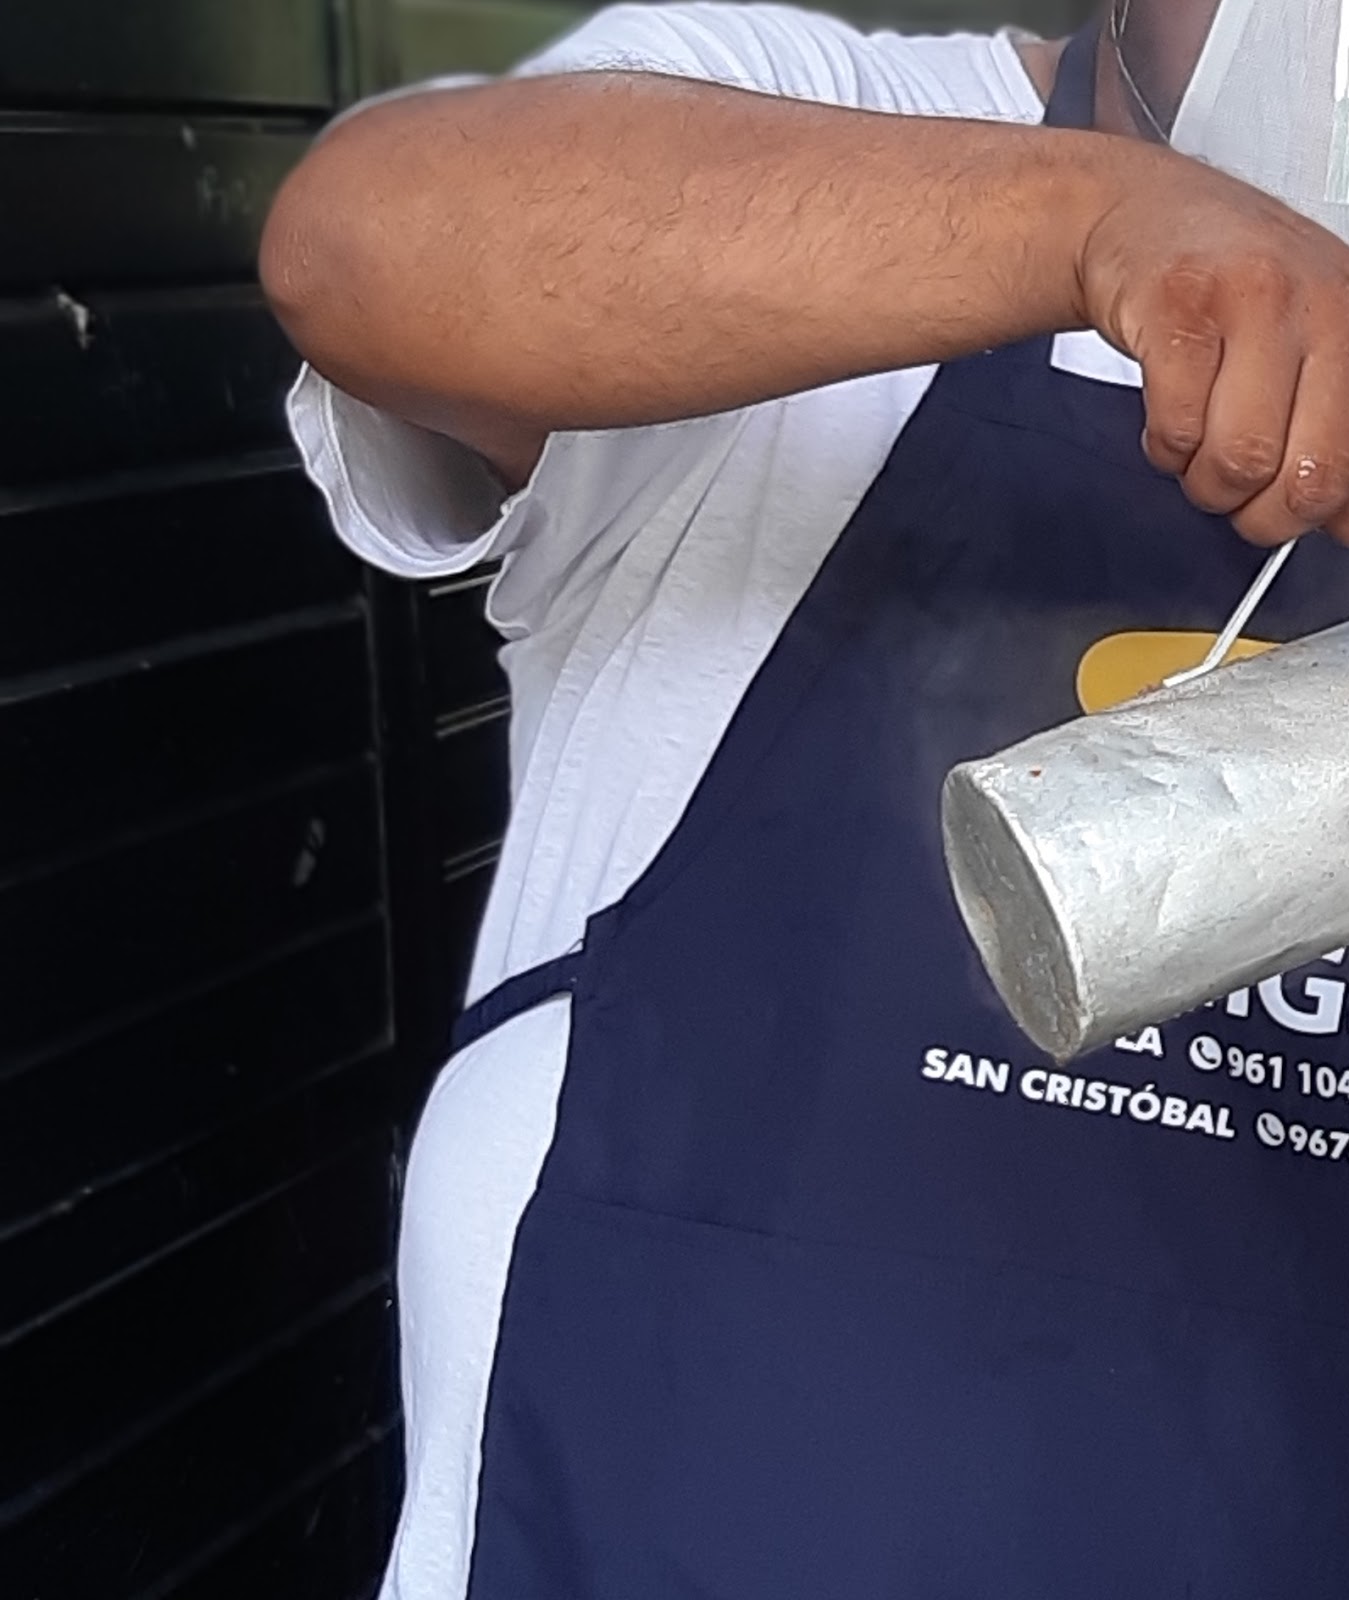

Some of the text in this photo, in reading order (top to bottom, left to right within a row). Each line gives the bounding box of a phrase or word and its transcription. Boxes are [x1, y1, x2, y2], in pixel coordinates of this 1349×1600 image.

[922, 1048, 1010, 1093] SAN
[1020, 1068, 1236, 1138] CRISTÓBAL
[1227, 1046, 1283, 1089] 961
